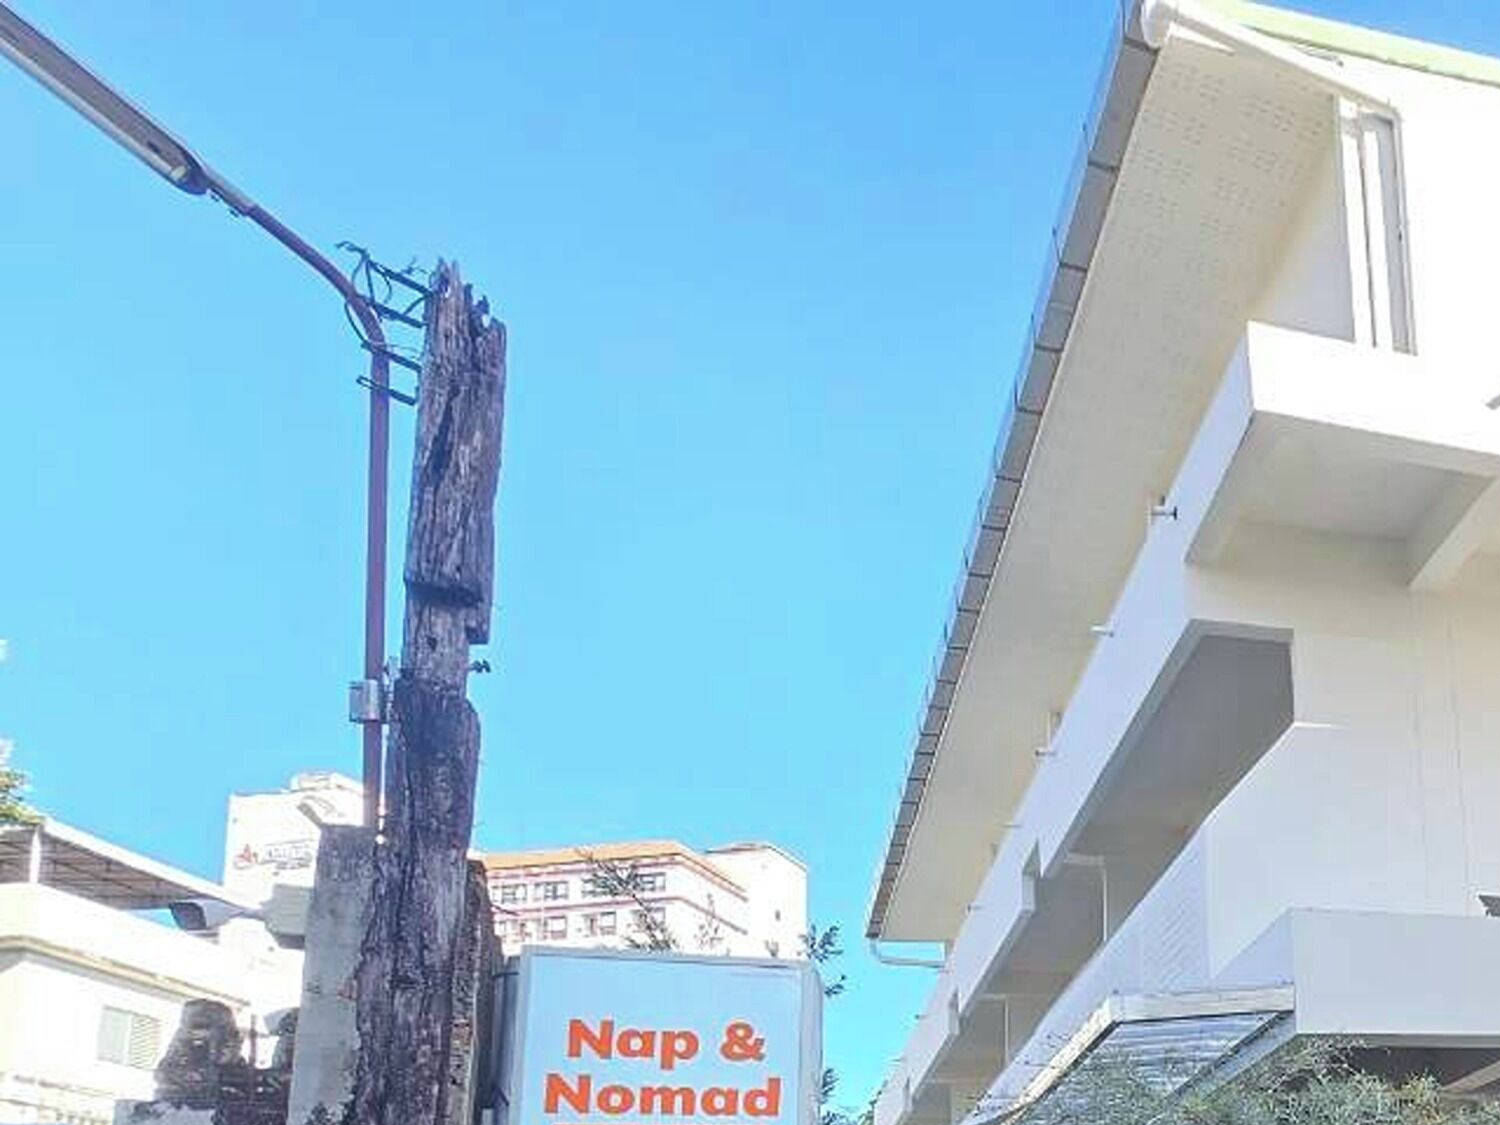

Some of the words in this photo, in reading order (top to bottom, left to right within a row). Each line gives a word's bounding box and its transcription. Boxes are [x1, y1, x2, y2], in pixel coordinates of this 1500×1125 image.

[567, 1018, 700, 1071] Nap
[719, 1020, 766, 1062] &
[543, 1072, 782, 1117] Nomad
